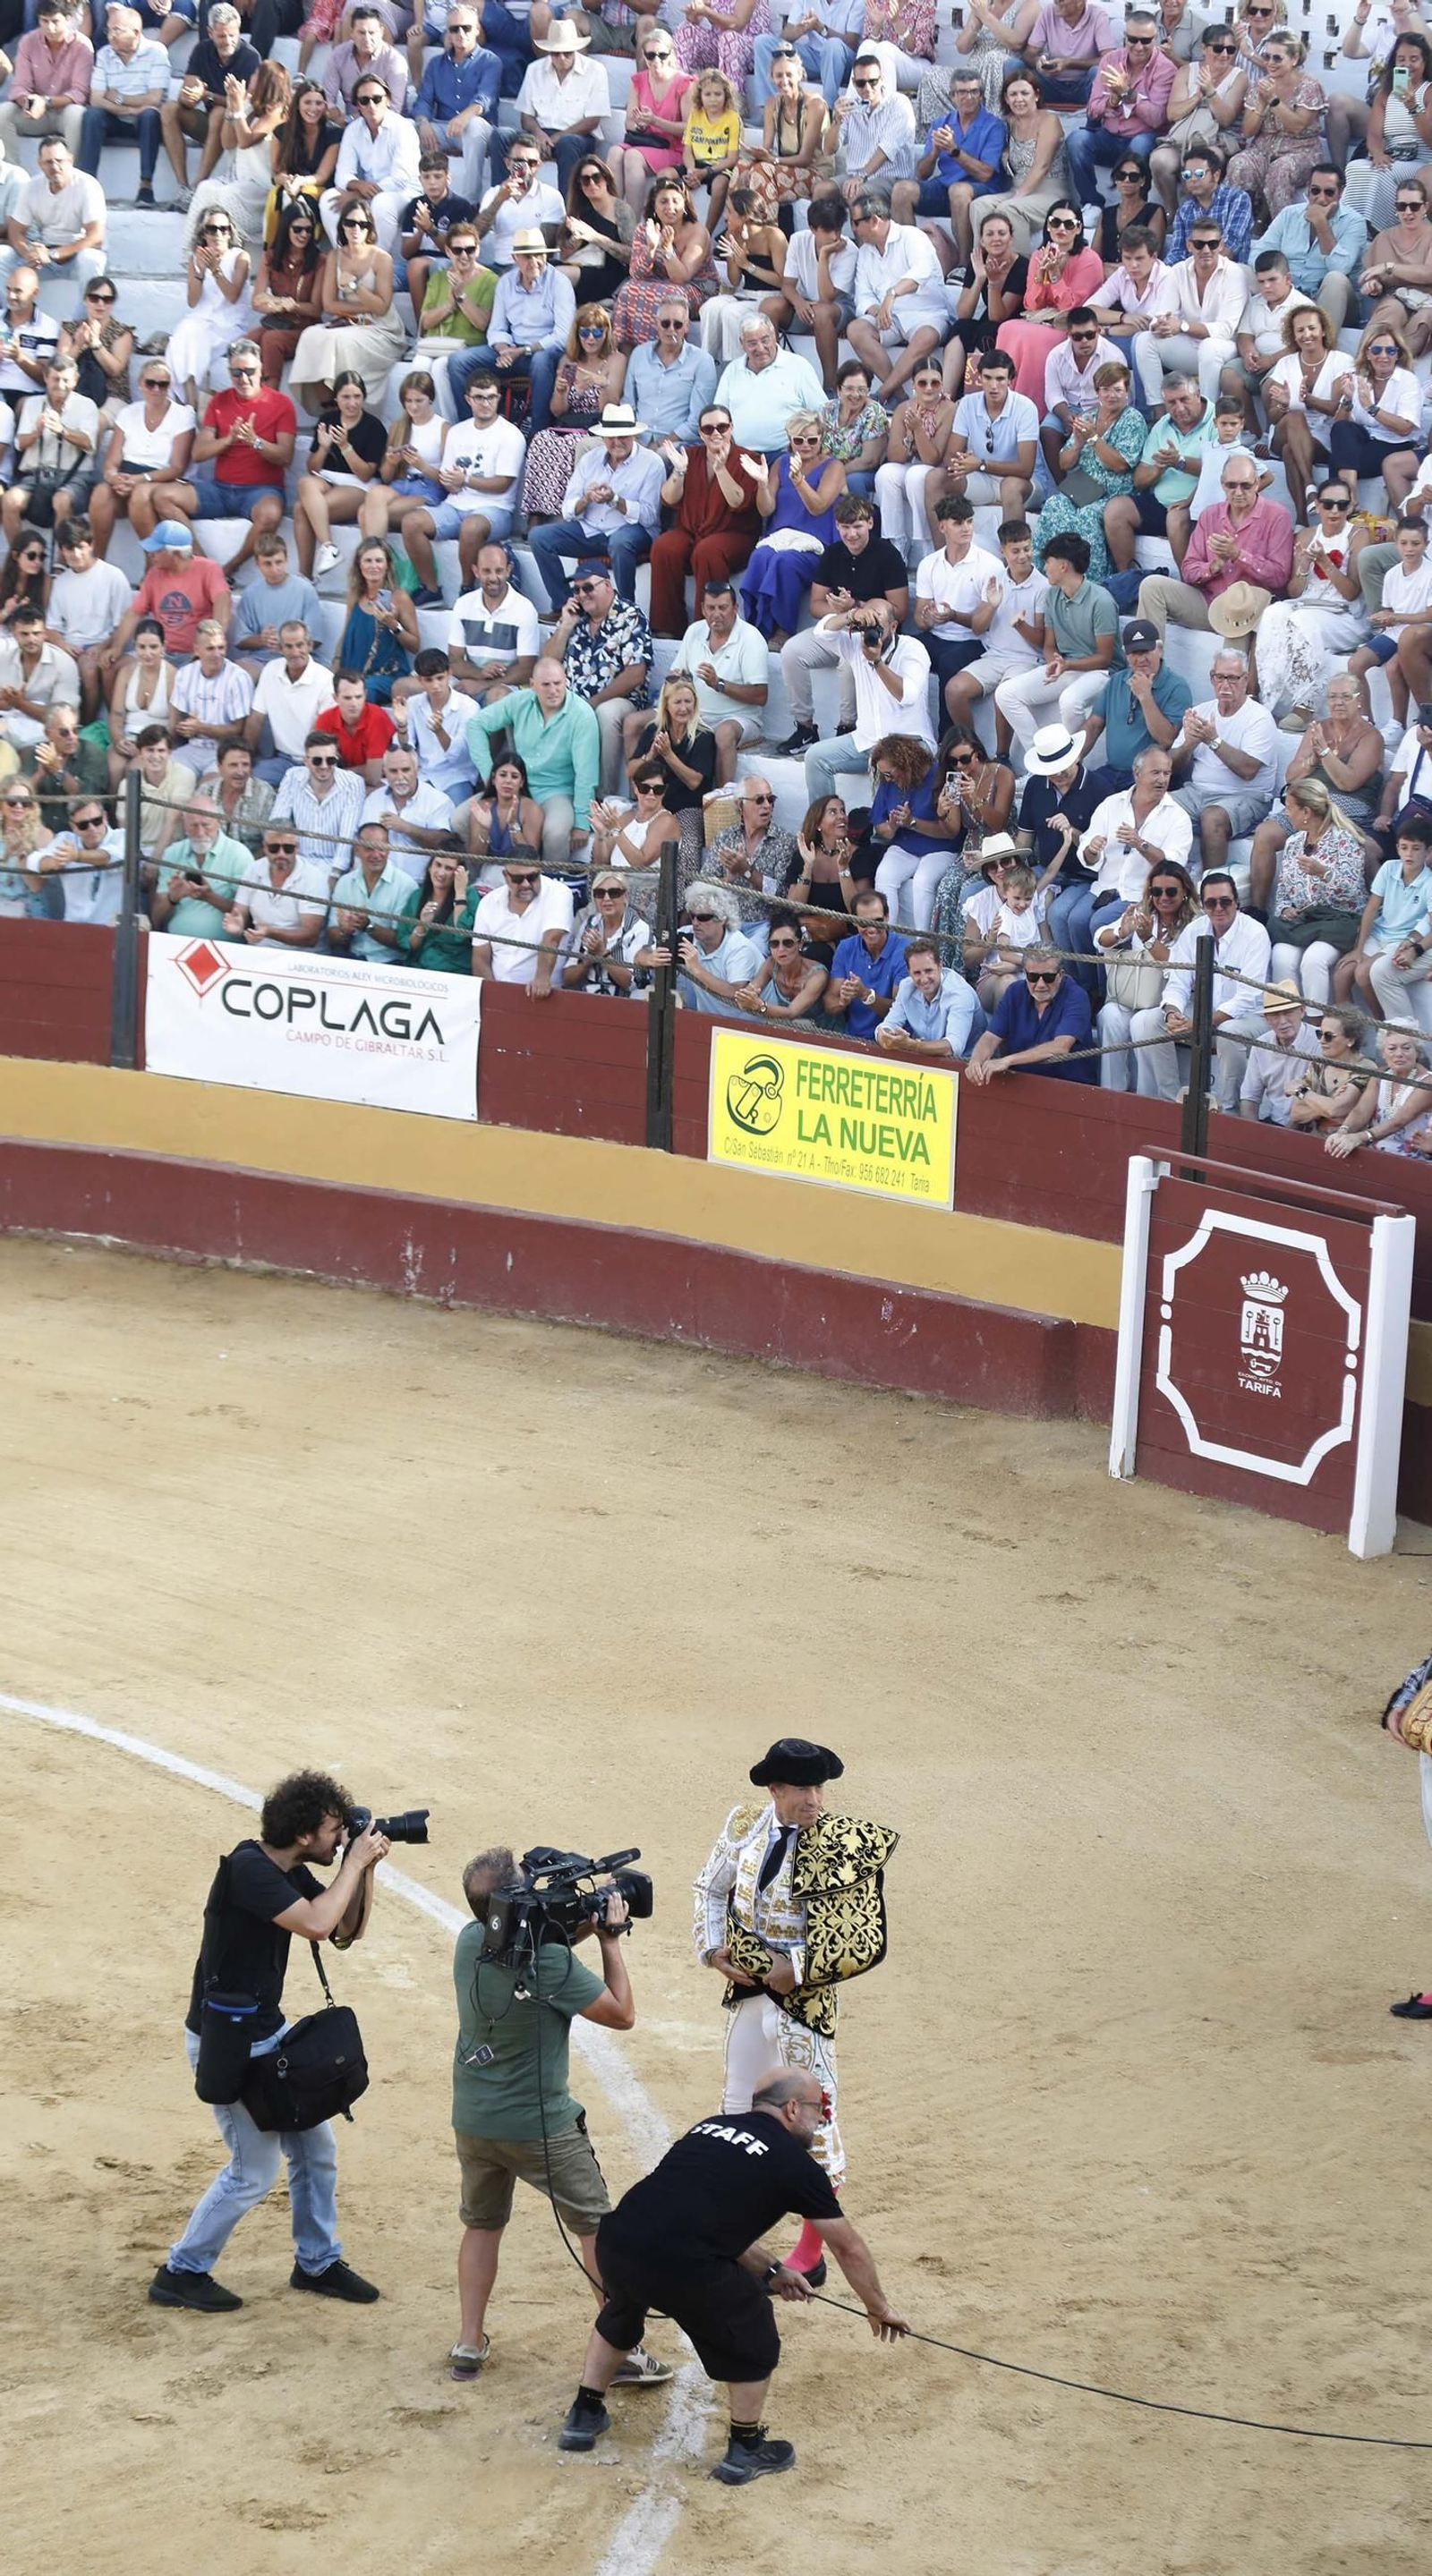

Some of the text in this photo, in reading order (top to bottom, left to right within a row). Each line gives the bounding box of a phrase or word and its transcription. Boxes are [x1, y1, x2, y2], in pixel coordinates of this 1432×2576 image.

[287, 963, 350, 980] LABORATORIOS
[352, 971, 372, 982] ALEX
[222, 979, 445, 1044] COPLAGA
[286, 1029, 332, 1047] CAMPO
[335, 1035, 352, 1050] DE
[355, 1039, 423, 1059] GIBRALTAR
[797, 1059, 937, 1123] FERRETERRÍA
[797, 1109, 931, 1165] LA NUEVA
[797, 1151, 806, 1169] 21
[809, 1153, 815, 1169] A
[859, 1162, 874, 1182] 956
[875, 1166, 889, 1186] 682
[891, 1169, 905, 1188] 241
[1238, 1377, 1282, 1399] TARIFA
[491, 1917, 499, 1930] 6
